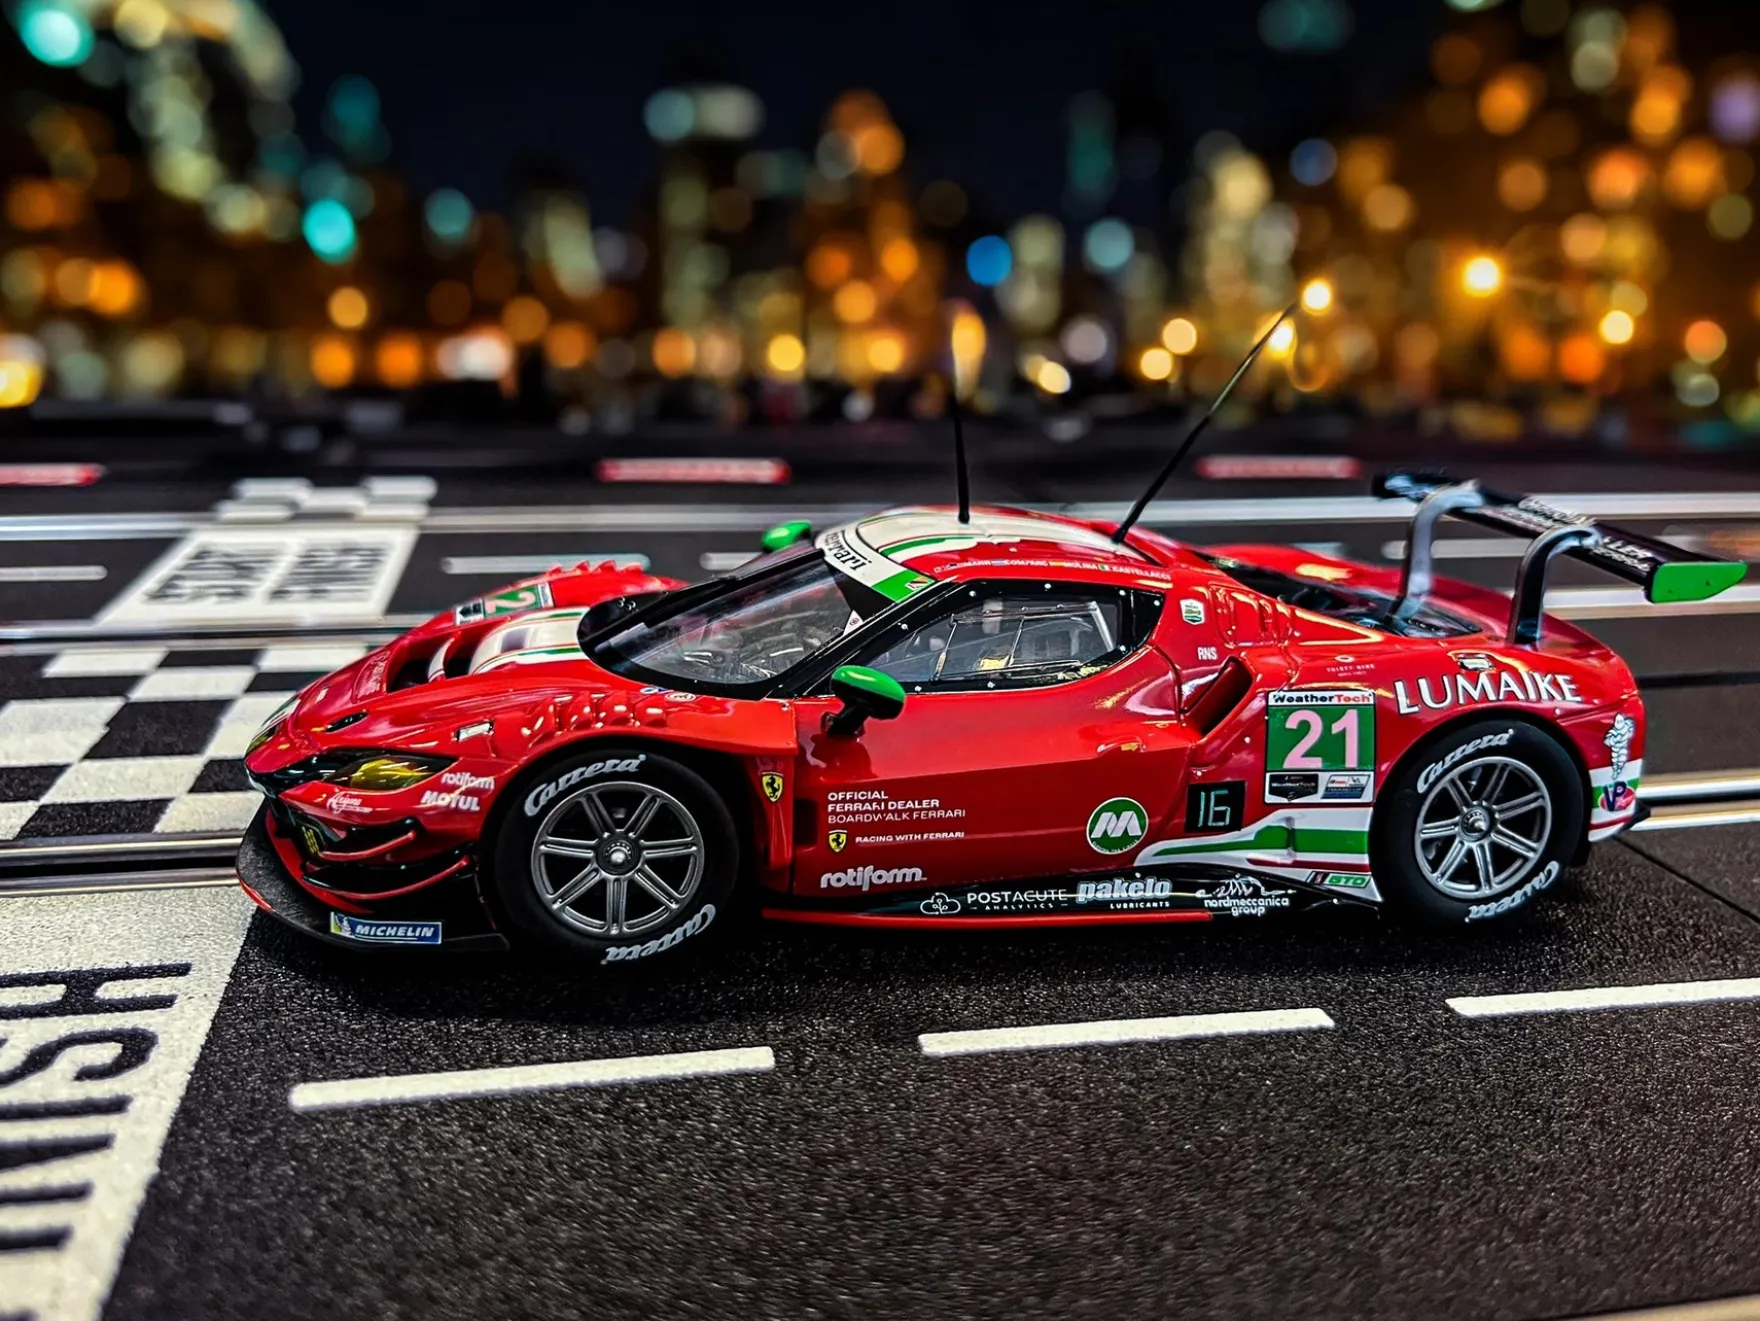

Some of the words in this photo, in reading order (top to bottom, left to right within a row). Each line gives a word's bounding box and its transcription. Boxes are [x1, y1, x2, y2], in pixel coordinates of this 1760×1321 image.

[825, 530, 870, 571] errari
[1394, 671, 1582, 714] LUMAIKE
[1283, 709, 1359, 769] 21
[1417, 730, 1511, 793] Carrera
[524, 756, 643, 817] Carrera
[827, 790, 889, 801] OFFICIAL
[420, 790, 481, 812] MOTUL
[827, 801, 885, 813] FERRARI
[888, 799, 940, 811] DEALER
[1198, 789, 1231, 828] 16
[827, 811, 910, 824] BOARDWALK
[913, 809, 966, 820] FERRARI
[855, 834, 893, 844] RACING
[895, 833, 922, 842] WITH
[923, 831, 965, 840] FERRARI
[820, 865, 924, 891] rotiform
[1076, 876, 1173, 903] pakelo
[967, 889, 1068, 904] POSTACUTE
[1204, 896, 1290, 908] nordmeccanica
[1466, 860, 1559, 921] Carrera
[1110, 901, 1170, 909] LUBRICANTS
[1231, 905, 1266, 917] group
[355, 923, 435, 938] MICHELIN
[603, 904, 716, 962] Carrera
